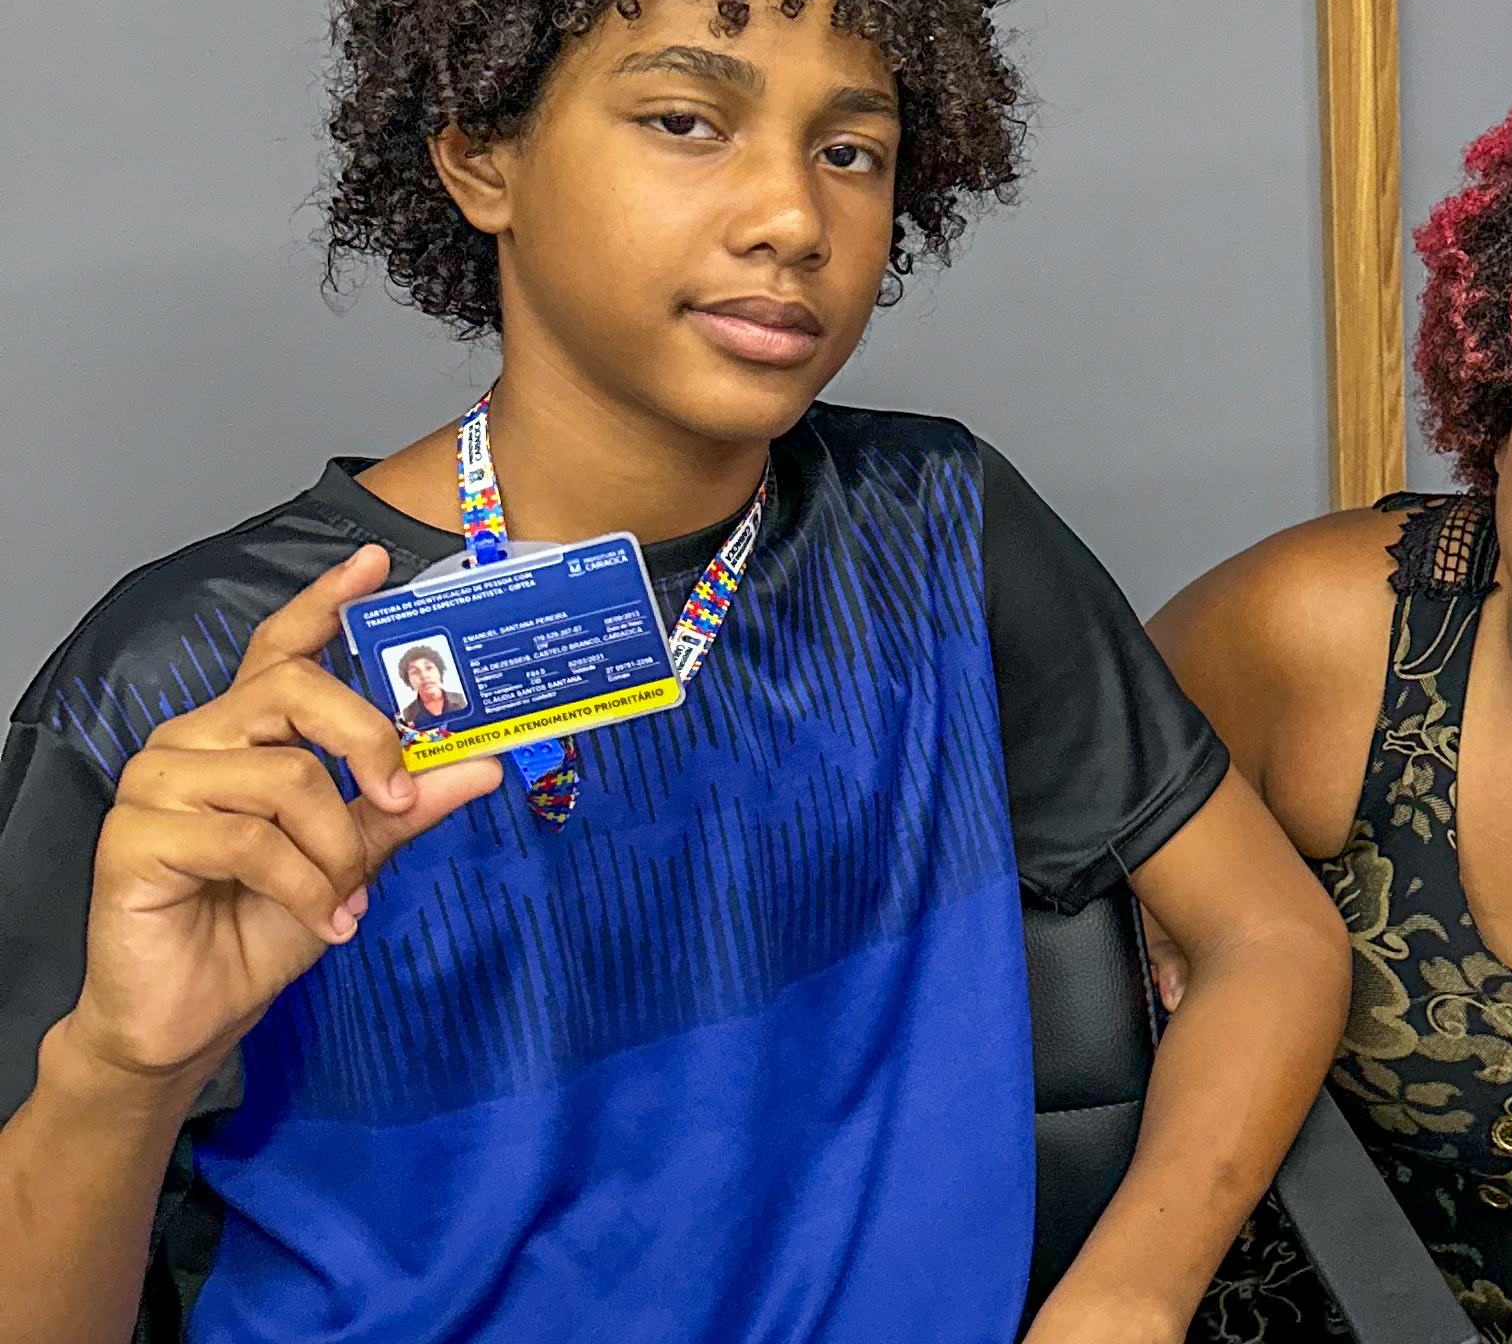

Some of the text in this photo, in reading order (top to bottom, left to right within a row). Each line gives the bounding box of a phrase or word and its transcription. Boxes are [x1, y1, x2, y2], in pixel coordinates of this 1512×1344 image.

[584, 554, 628, 572] CARIACICA
[431, 595, 471, 611] ESPECTRO
[471, 587, 503, 601] AUTISTA
[362, 604, 401, 620] CARTEIRA
[499, 619, 534, 634] SANTANA
[547, 674, 581, 688] SANTANA
[413, 741, 454, 759] TENHO
[455, 729, 500, 748] DIREITO
[512, 705, 592, 733] ATENDIMENTO
[593, 684, 664, 712] PRIORITÁRIO
